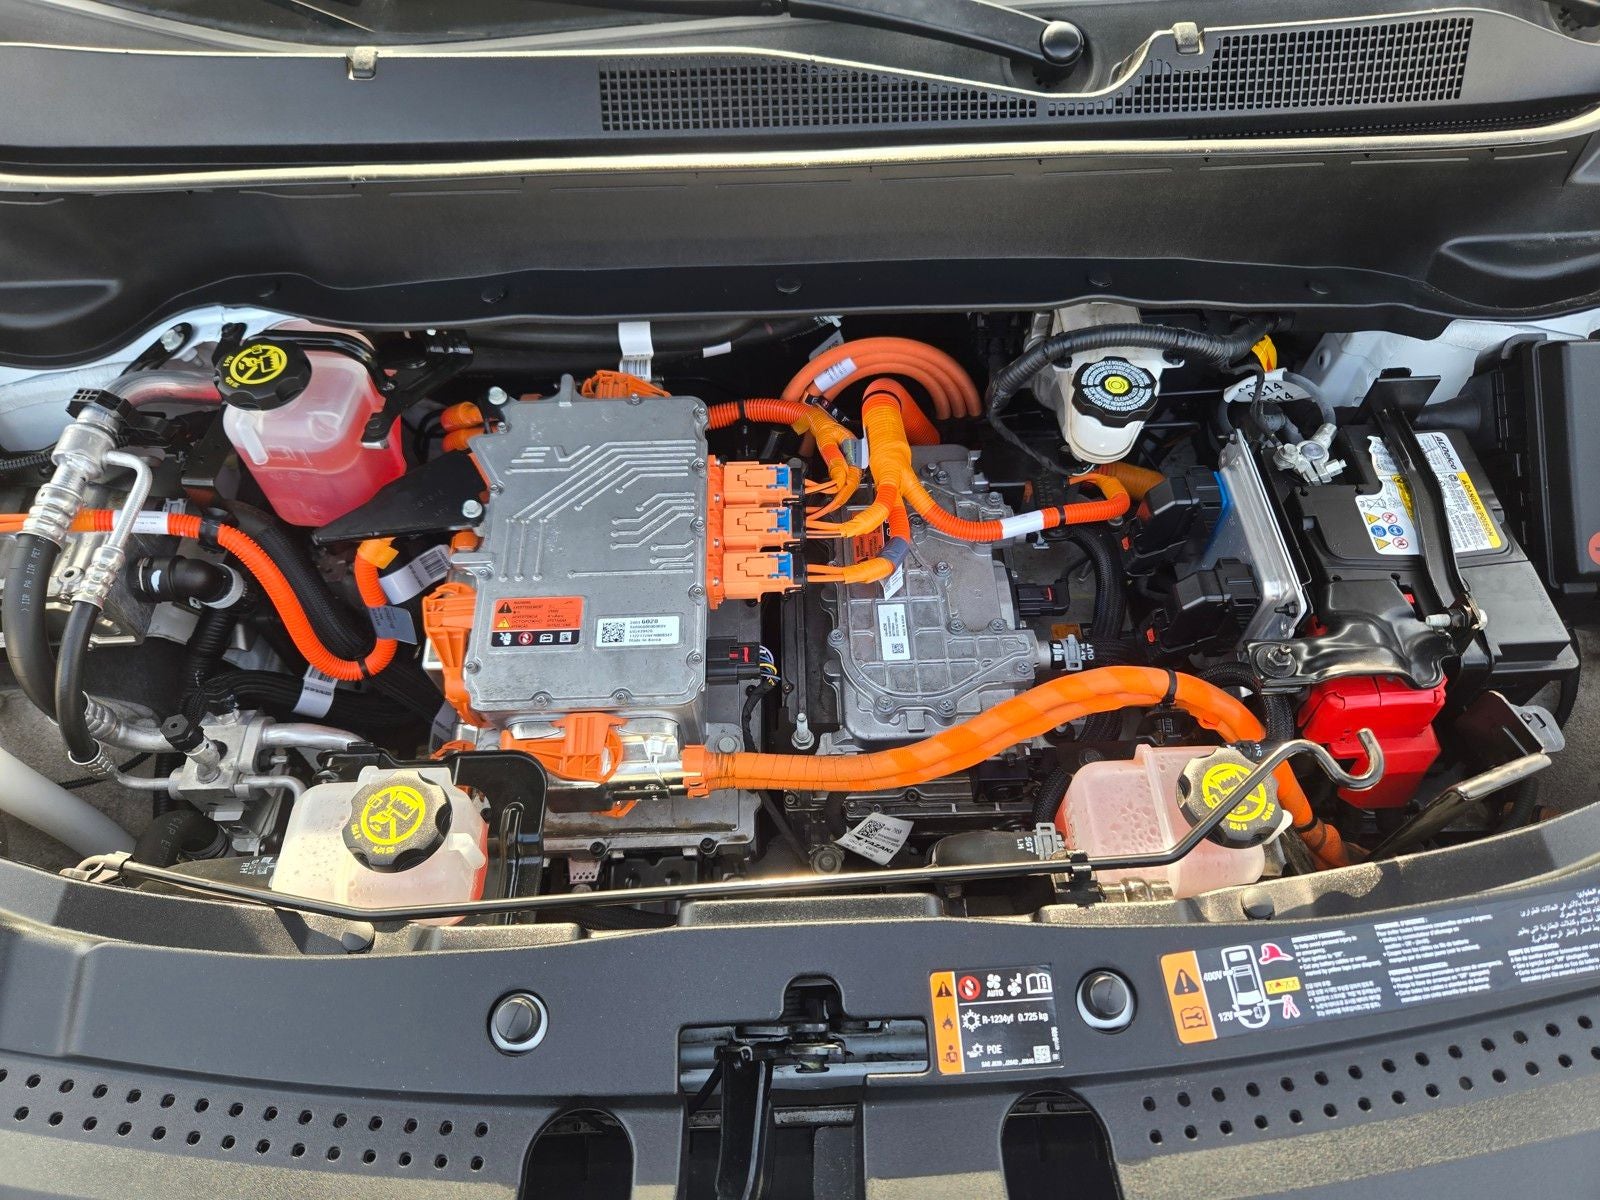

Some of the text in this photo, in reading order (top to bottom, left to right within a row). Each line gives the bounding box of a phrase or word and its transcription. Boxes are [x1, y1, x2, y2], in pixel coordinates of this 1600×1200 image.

[864, 839, 894, 854] YAZAKI
[1017, 838, 1024, 850] LH
[1025, 836, 1034, 853] SGT
[240, 862, 250, 874] RH
[986, 989, 1004, 998] AUTO
[1018, 1012, 1038, 1022] 0.725
[1038, 1012, 1049, 1022] kg
[1218, 1011, 1233, 1022] 12V
[986, 1045, 1002, 1054] POE
